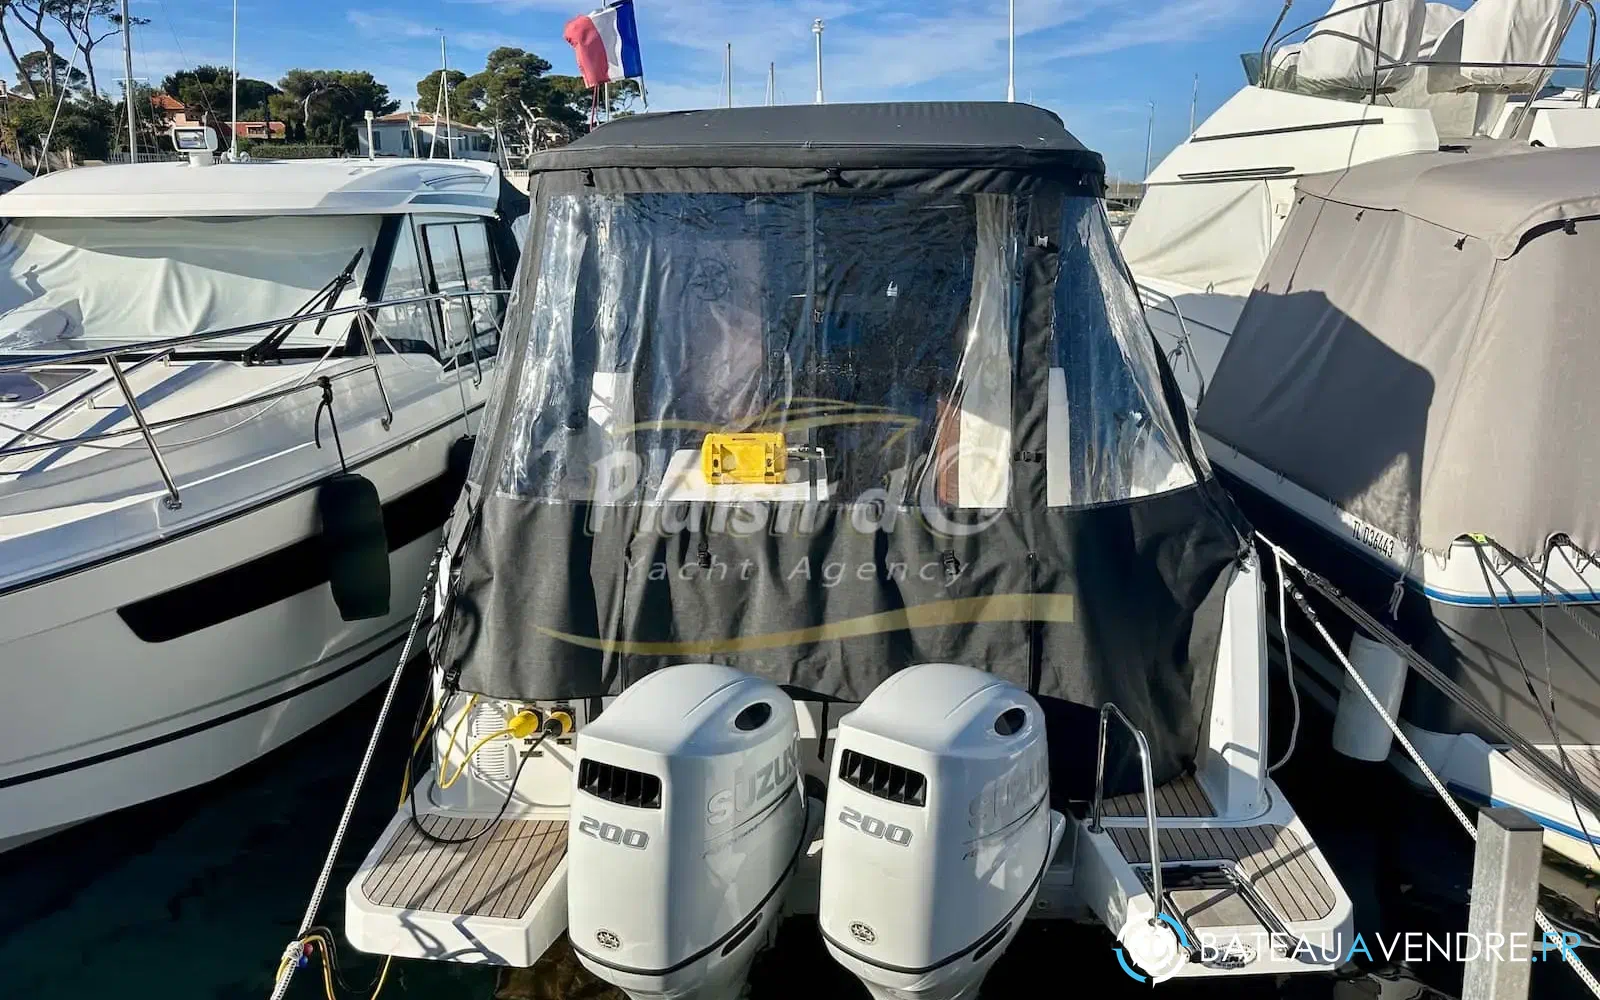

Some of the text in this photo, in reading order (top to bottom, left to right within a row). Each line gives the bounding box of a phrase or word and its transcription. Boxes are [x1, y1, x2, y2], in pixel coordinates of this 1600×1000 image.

[1352, 520, 1361, 541] TL
[578, 815, 650, 851] 200
[838, 805, 914, 848] 200
